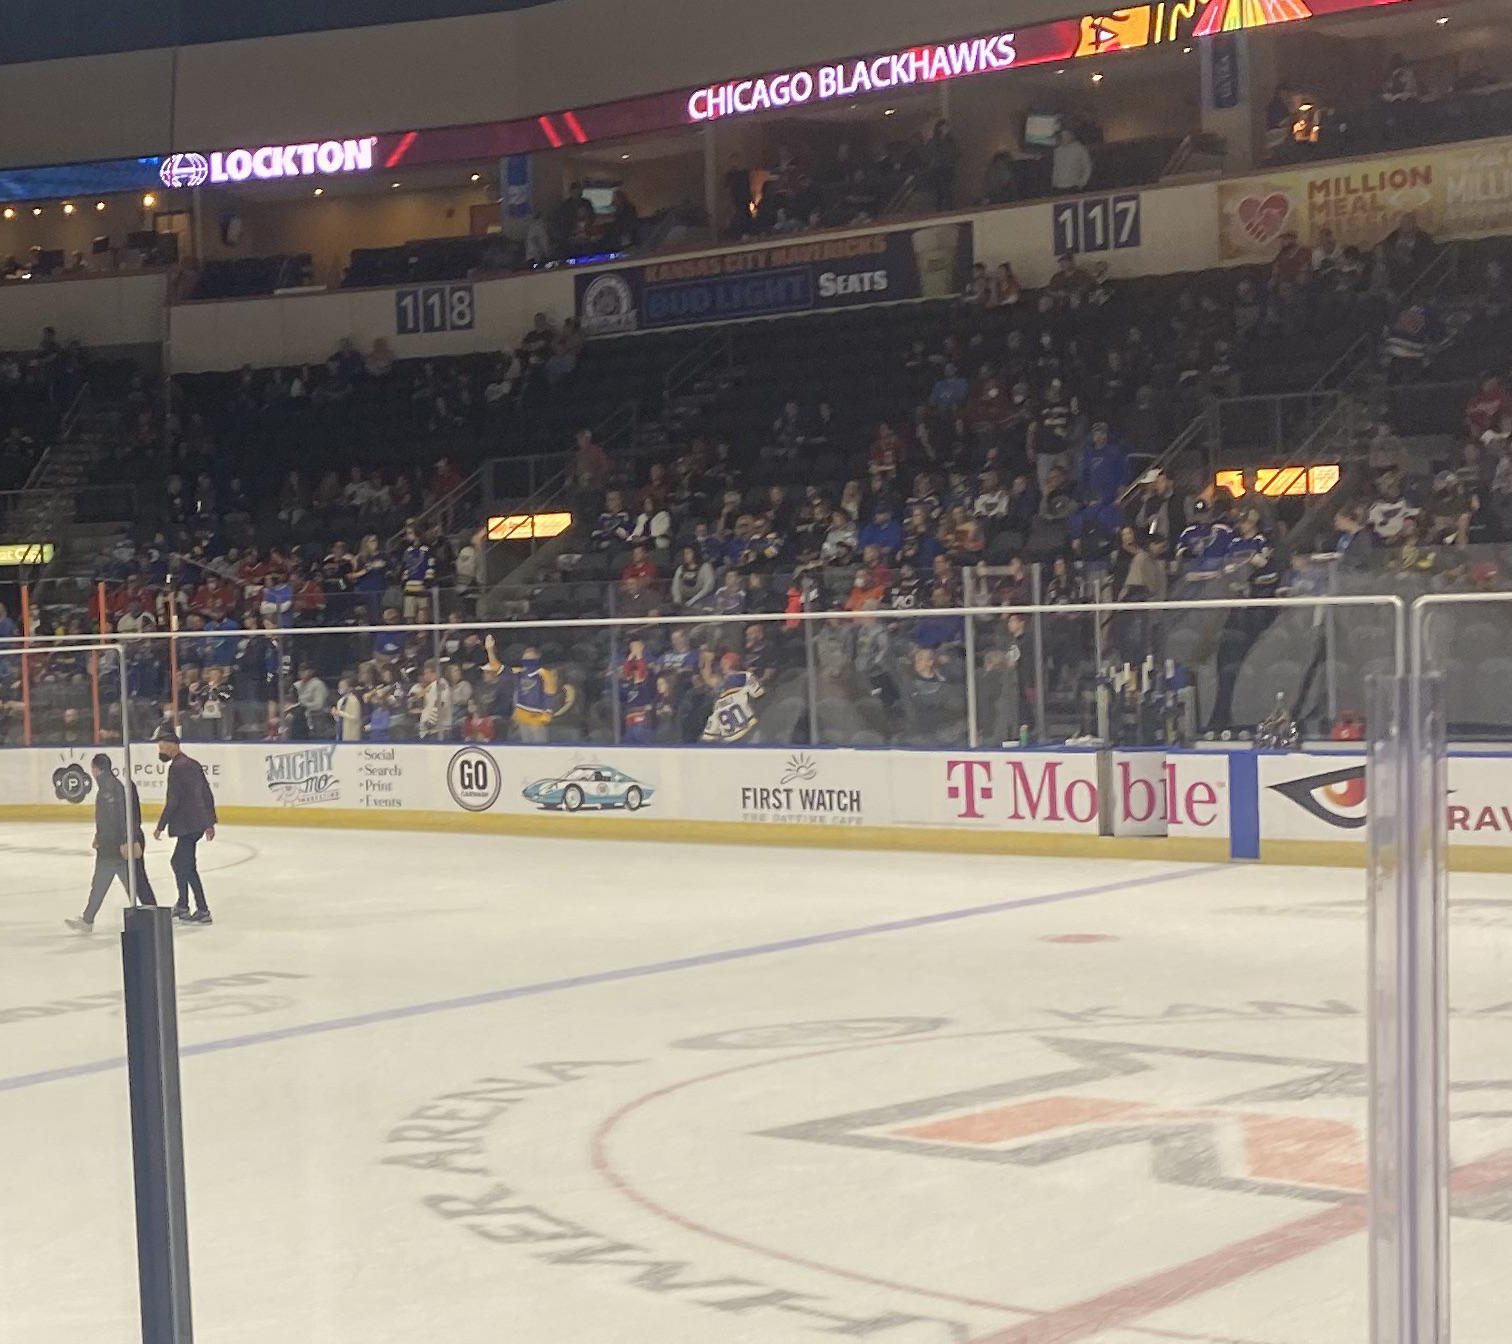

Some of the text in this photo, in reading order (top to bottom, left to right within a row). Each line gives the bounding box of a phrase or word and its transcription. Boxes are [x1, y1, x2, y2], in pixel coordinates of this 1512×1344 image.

[688, 32, 1016, 121] CHICAGO BLACKHAWKS
[210, 138, 374, 184] LOCKTON
[1307, 165, 1433, 200] MILLION
[1058, 197, 1138, 250] 117
[399, 287, 472, 330] 118
[266, 745, 336, 782] MIGHTY
[364, 748, 395, 761] Social
[365, 764, 402, 777] Search
[365, 779, 393, 792] Print
[459, 759, 488, 790] GO
[365, 794, 402, 807] Events
[742, 787, 862, 812] FIRST WATCH
